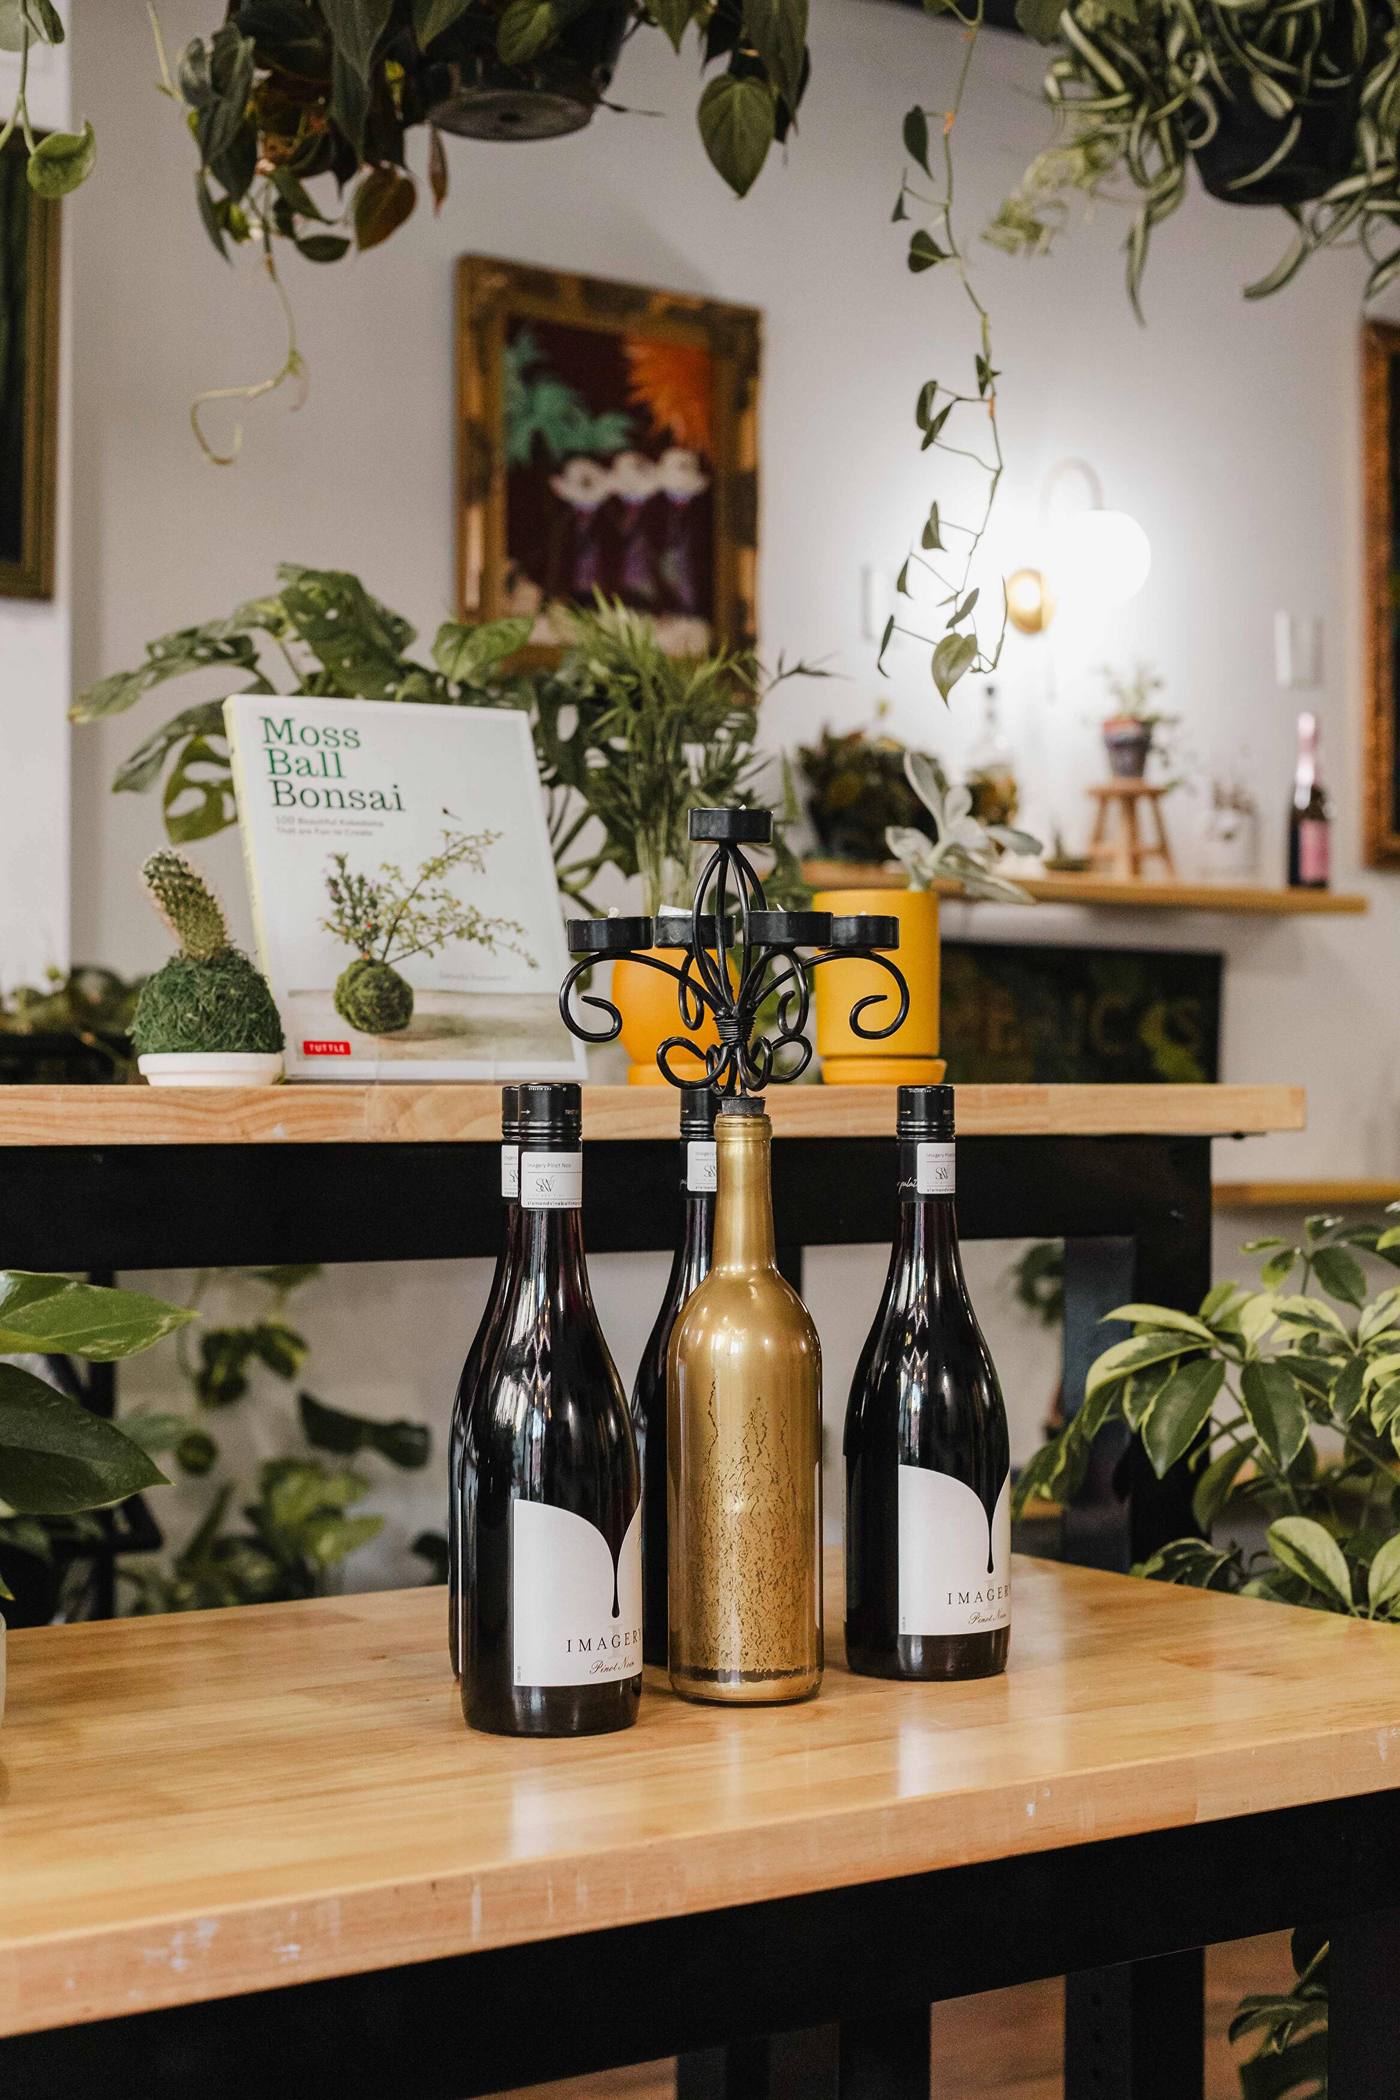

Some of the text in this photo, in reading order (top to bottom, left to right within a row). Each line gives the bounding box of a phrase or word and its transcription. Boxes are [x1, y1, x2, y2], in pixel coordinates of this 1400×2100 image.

[259, 716, 361, 749] Moss
[264, 748, 347, 778] Ball
[268, 779, 406, 812] Bonsai
[309, 1043, 345, 1053] TUTTLE
[968, 1611, 993, 1625] Pinot
[589, 1659, 618, 1675] Pinot
